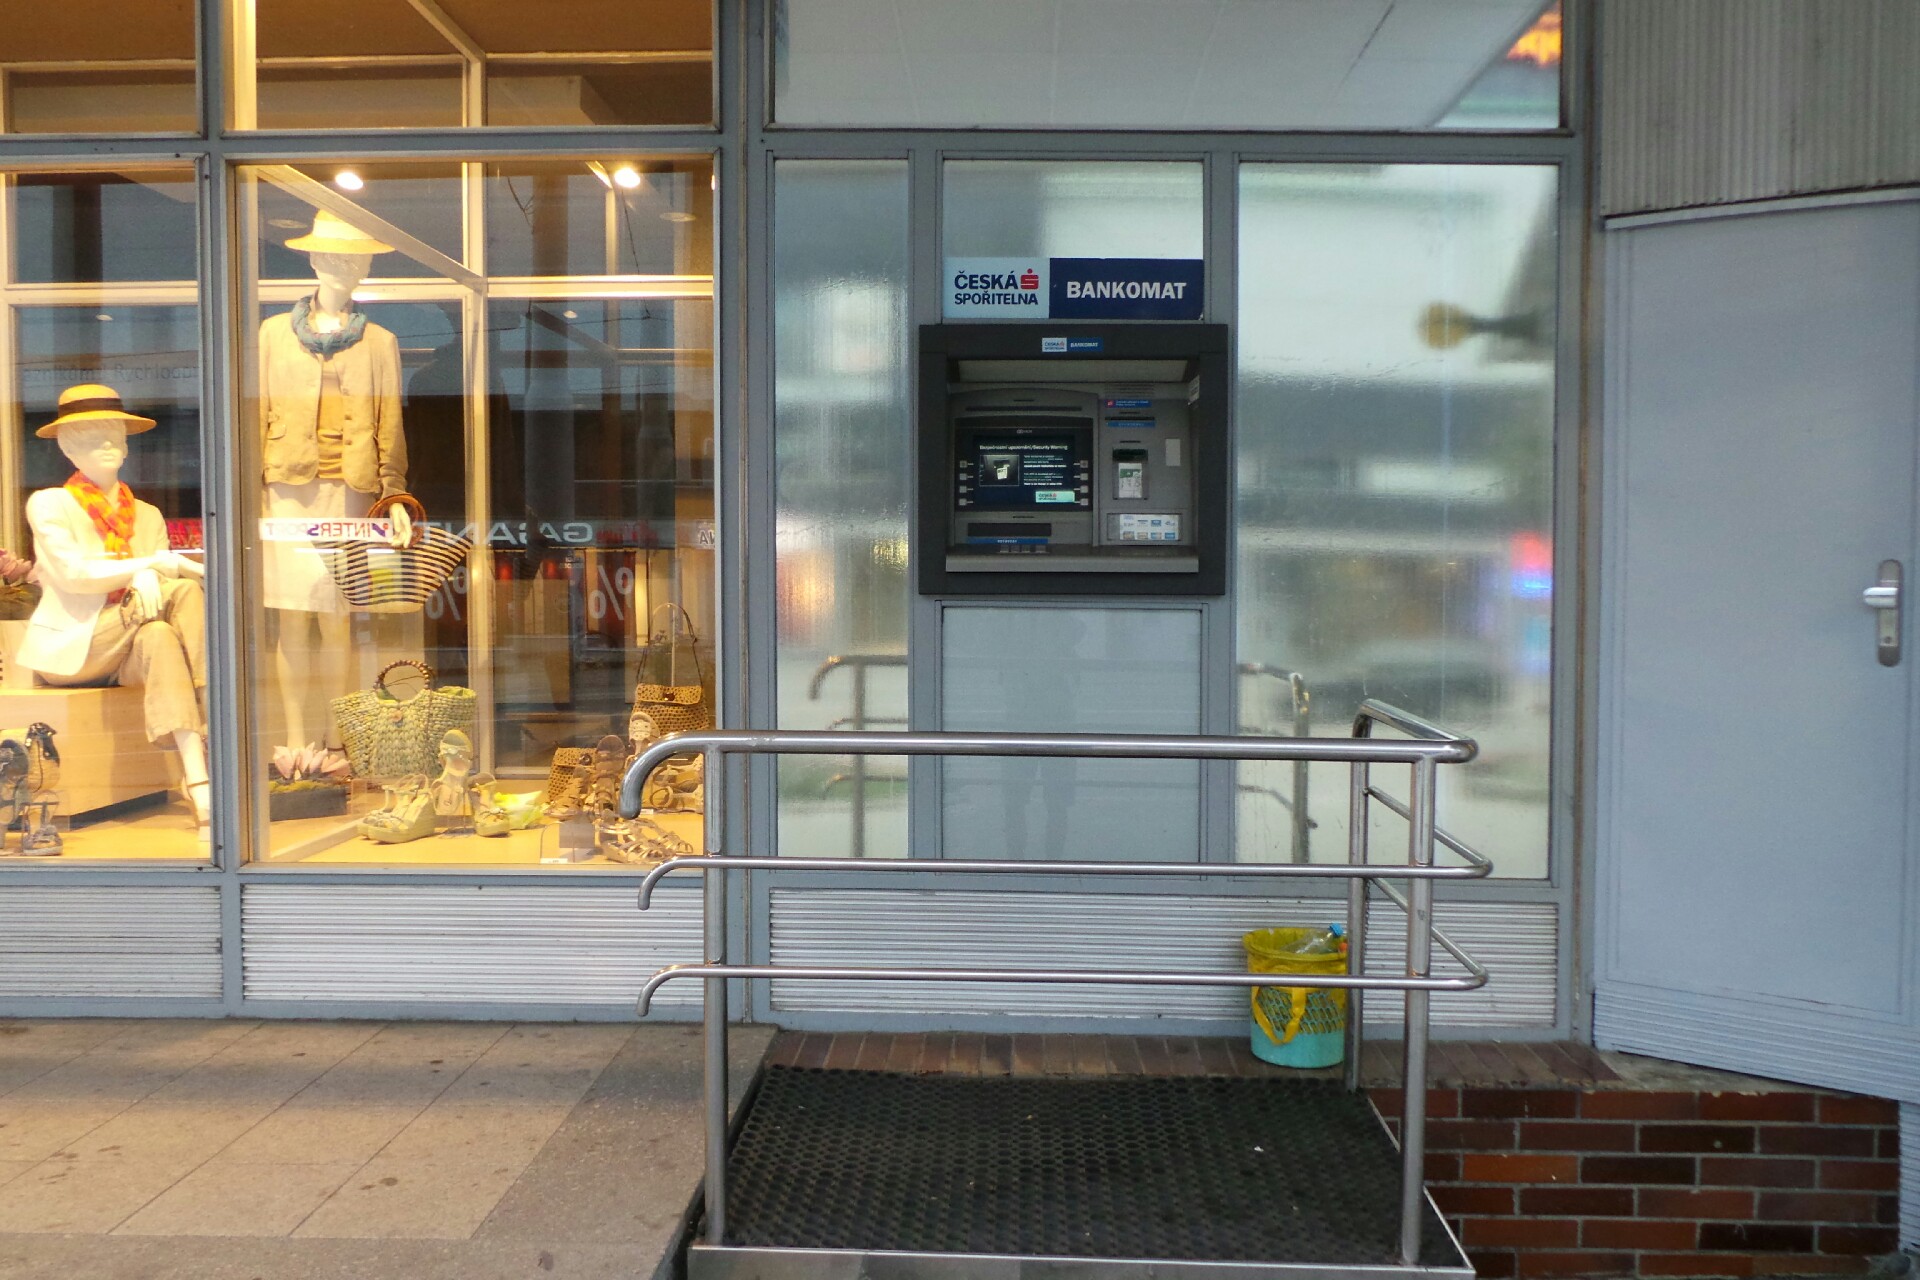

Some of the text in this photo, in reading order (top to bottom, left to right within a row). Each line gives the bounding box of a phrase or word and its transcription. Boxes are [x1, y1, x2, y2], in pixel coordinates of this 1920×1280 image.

[954, 270, 1019, 290] ČESKÁ
[954, 290, 1039, 306] SPOŘITELNA
[1066, 281, 1187, 300] BANKOMAT
